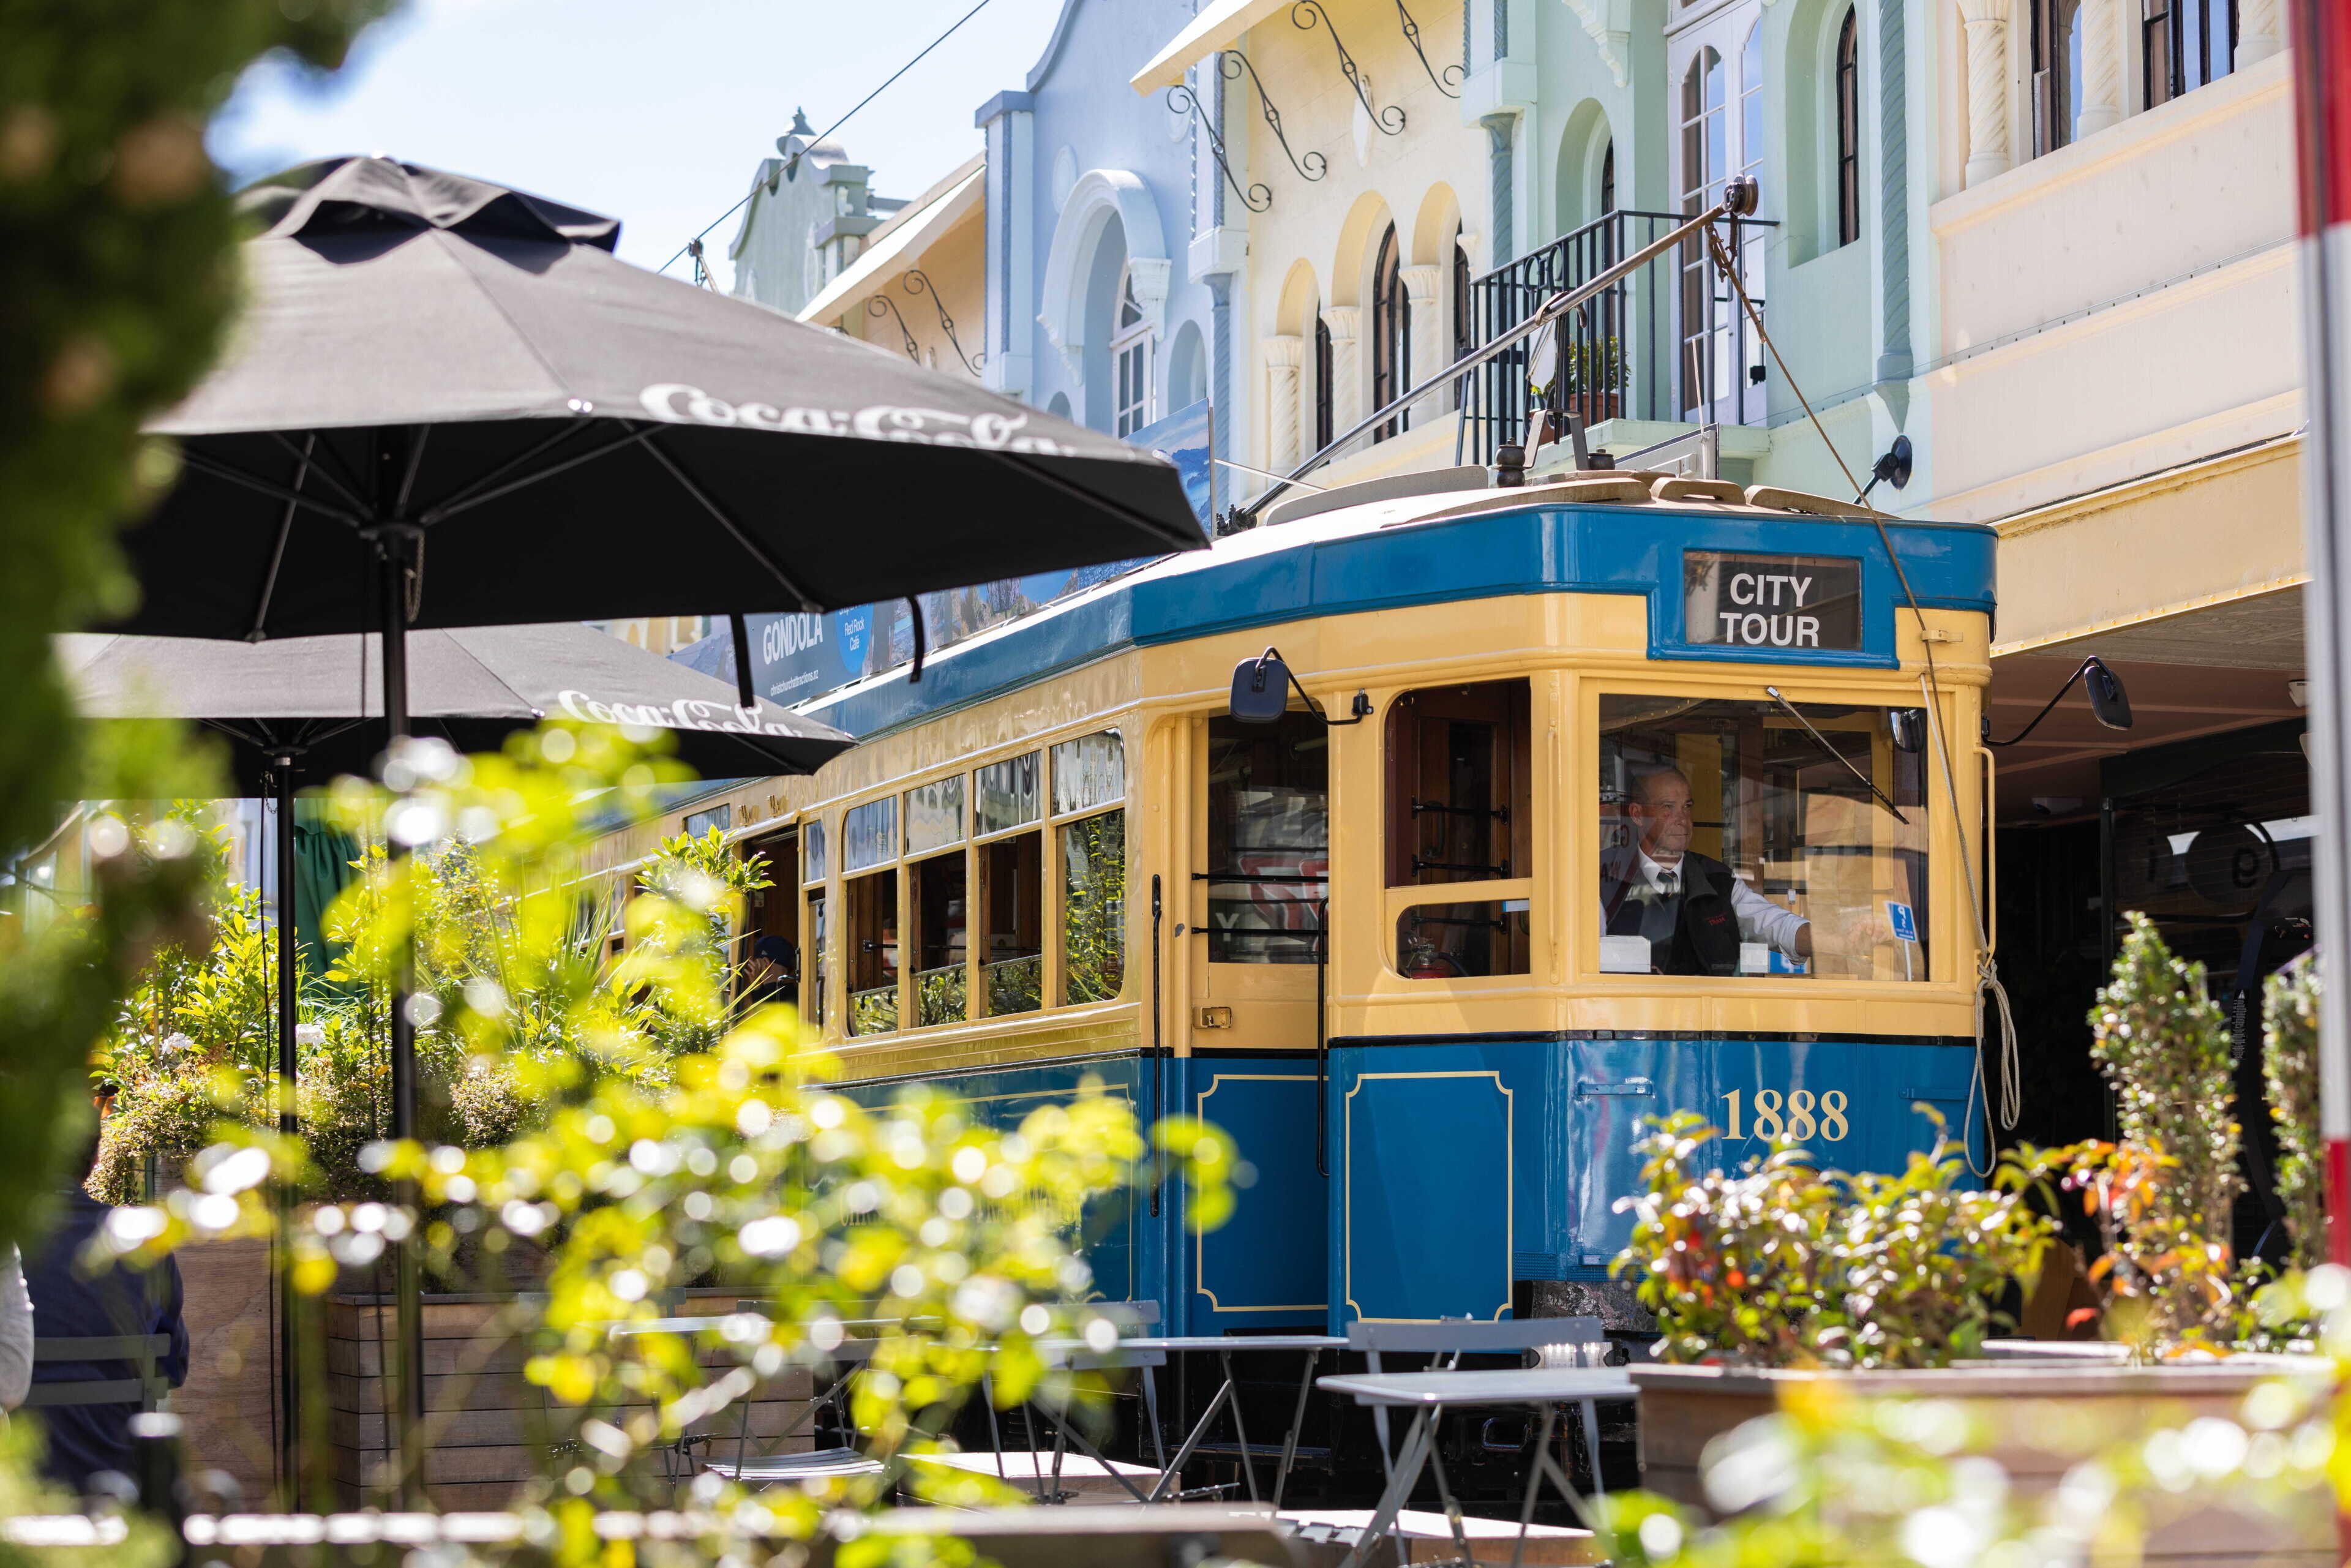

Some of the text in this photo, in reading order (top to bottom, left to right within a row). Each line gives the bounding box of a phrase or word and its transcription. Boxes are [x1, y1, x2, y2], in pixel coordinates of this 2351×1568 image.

[1730, 573, 1812, 607] CITY
[763, 612, 823, 665] GONDOLA
[845, 616, 864, 637] Red Rock
[1719, 612, 1820, 647] TOUR
[1721, 1089, 1849, 1142] 1888
